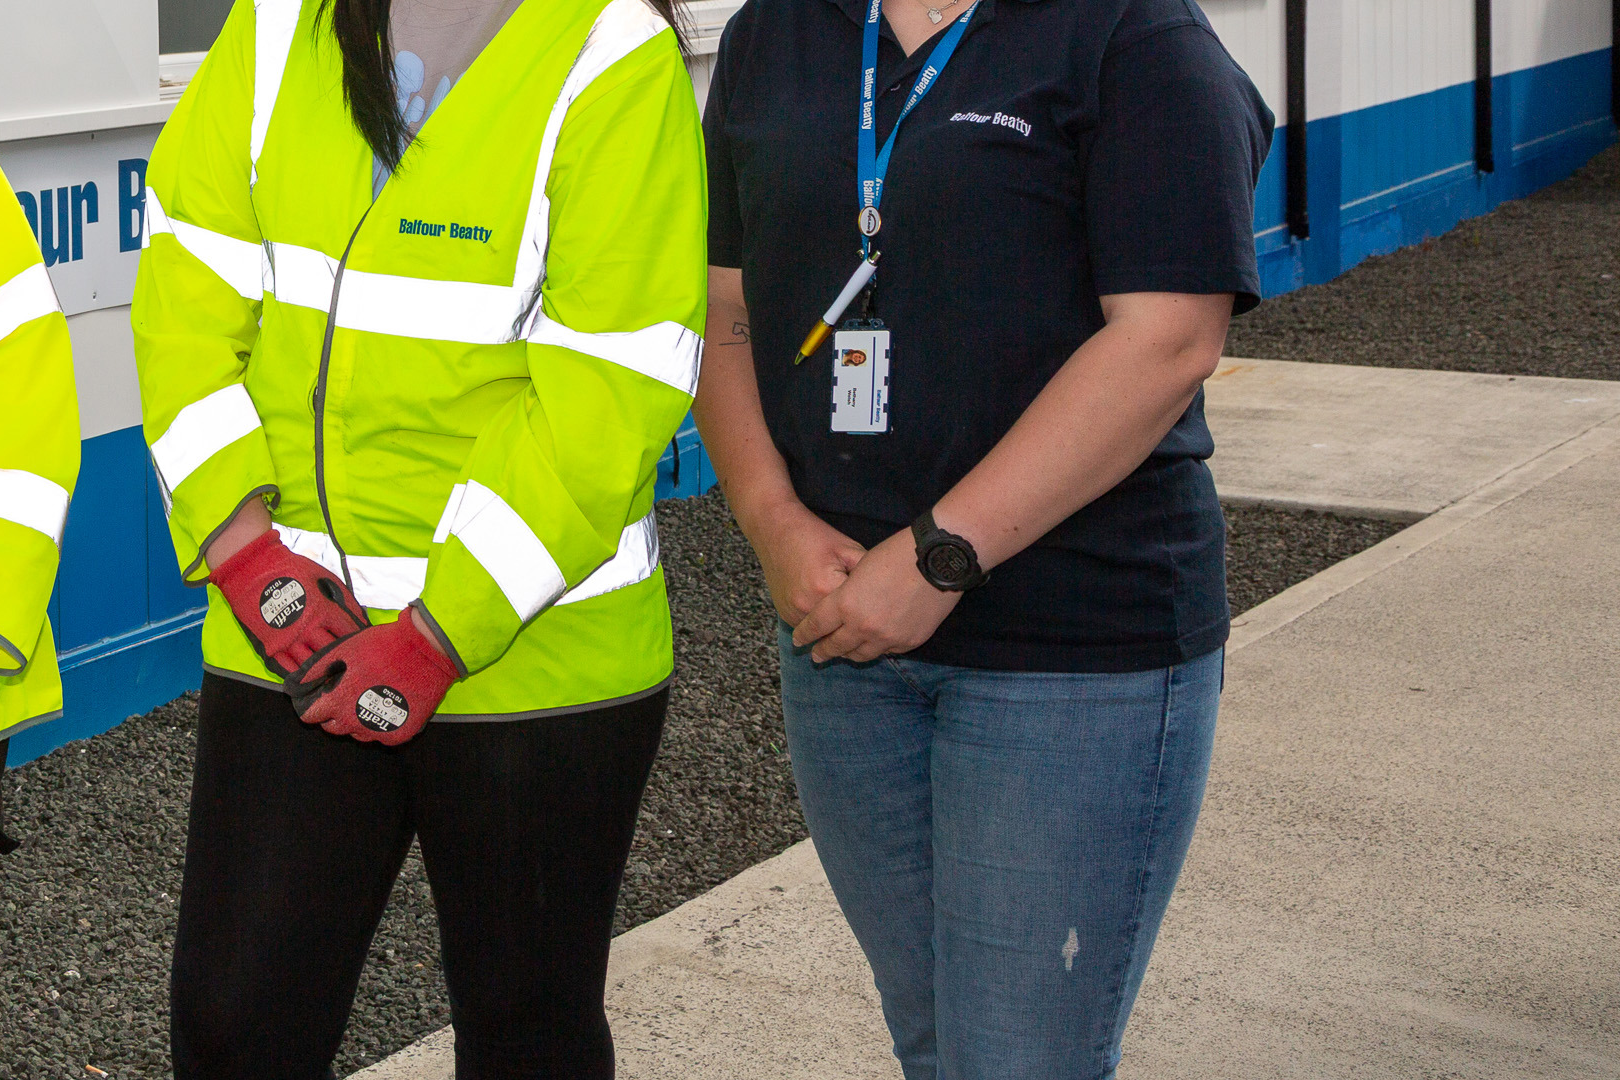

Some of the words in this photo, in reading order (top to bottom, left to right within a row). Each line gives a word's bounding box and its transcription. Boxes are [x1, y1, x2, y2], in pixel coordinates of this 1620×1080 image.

[863, 67, 875, 100] Balfour
[914, 65, 938, 96] Beatty
[861, 100, 873, 130] Beatty
[992, 112, 1032, 137] Beatty
[399, 218, 446, 237] Balfour
[450, 223, 493, 244] Beatty
[382, 688, 403, 704] TG1240
